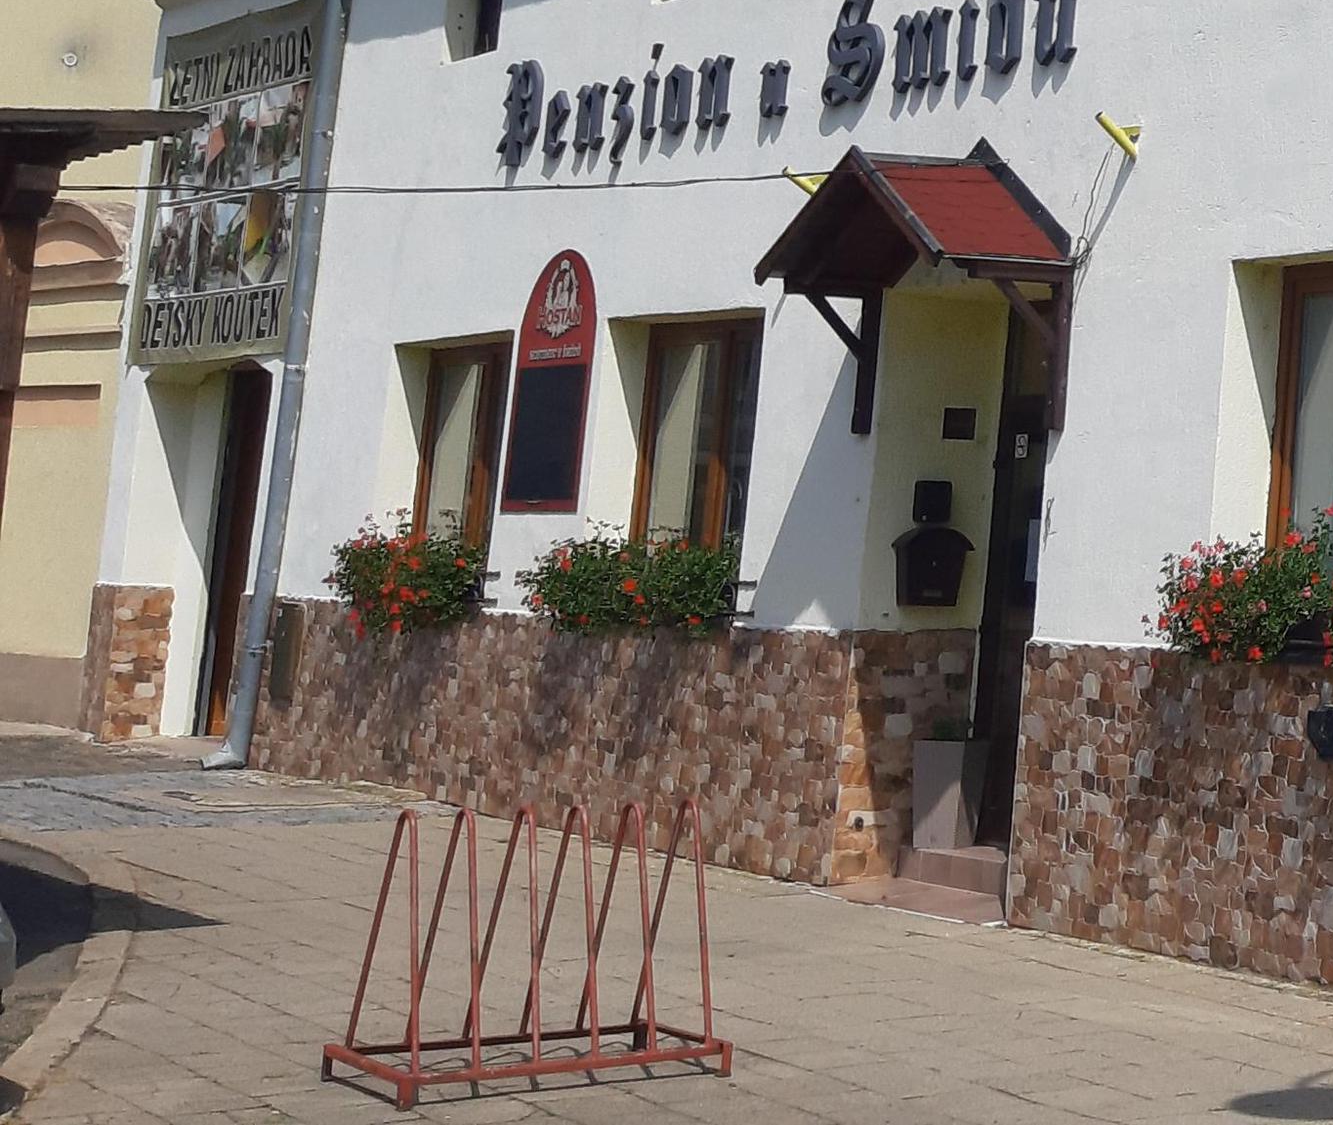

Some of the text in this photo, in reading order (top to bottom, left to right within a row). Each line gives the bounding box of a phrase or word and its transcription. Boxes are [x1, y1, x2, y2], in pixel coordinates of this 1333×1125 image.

[223, 25, 312, 94] ZAHRADA
[496, 43, 735, 167] Penzion
[760, 59, 791, 118] u
[211, 286, 286, 344] KOUTEK
